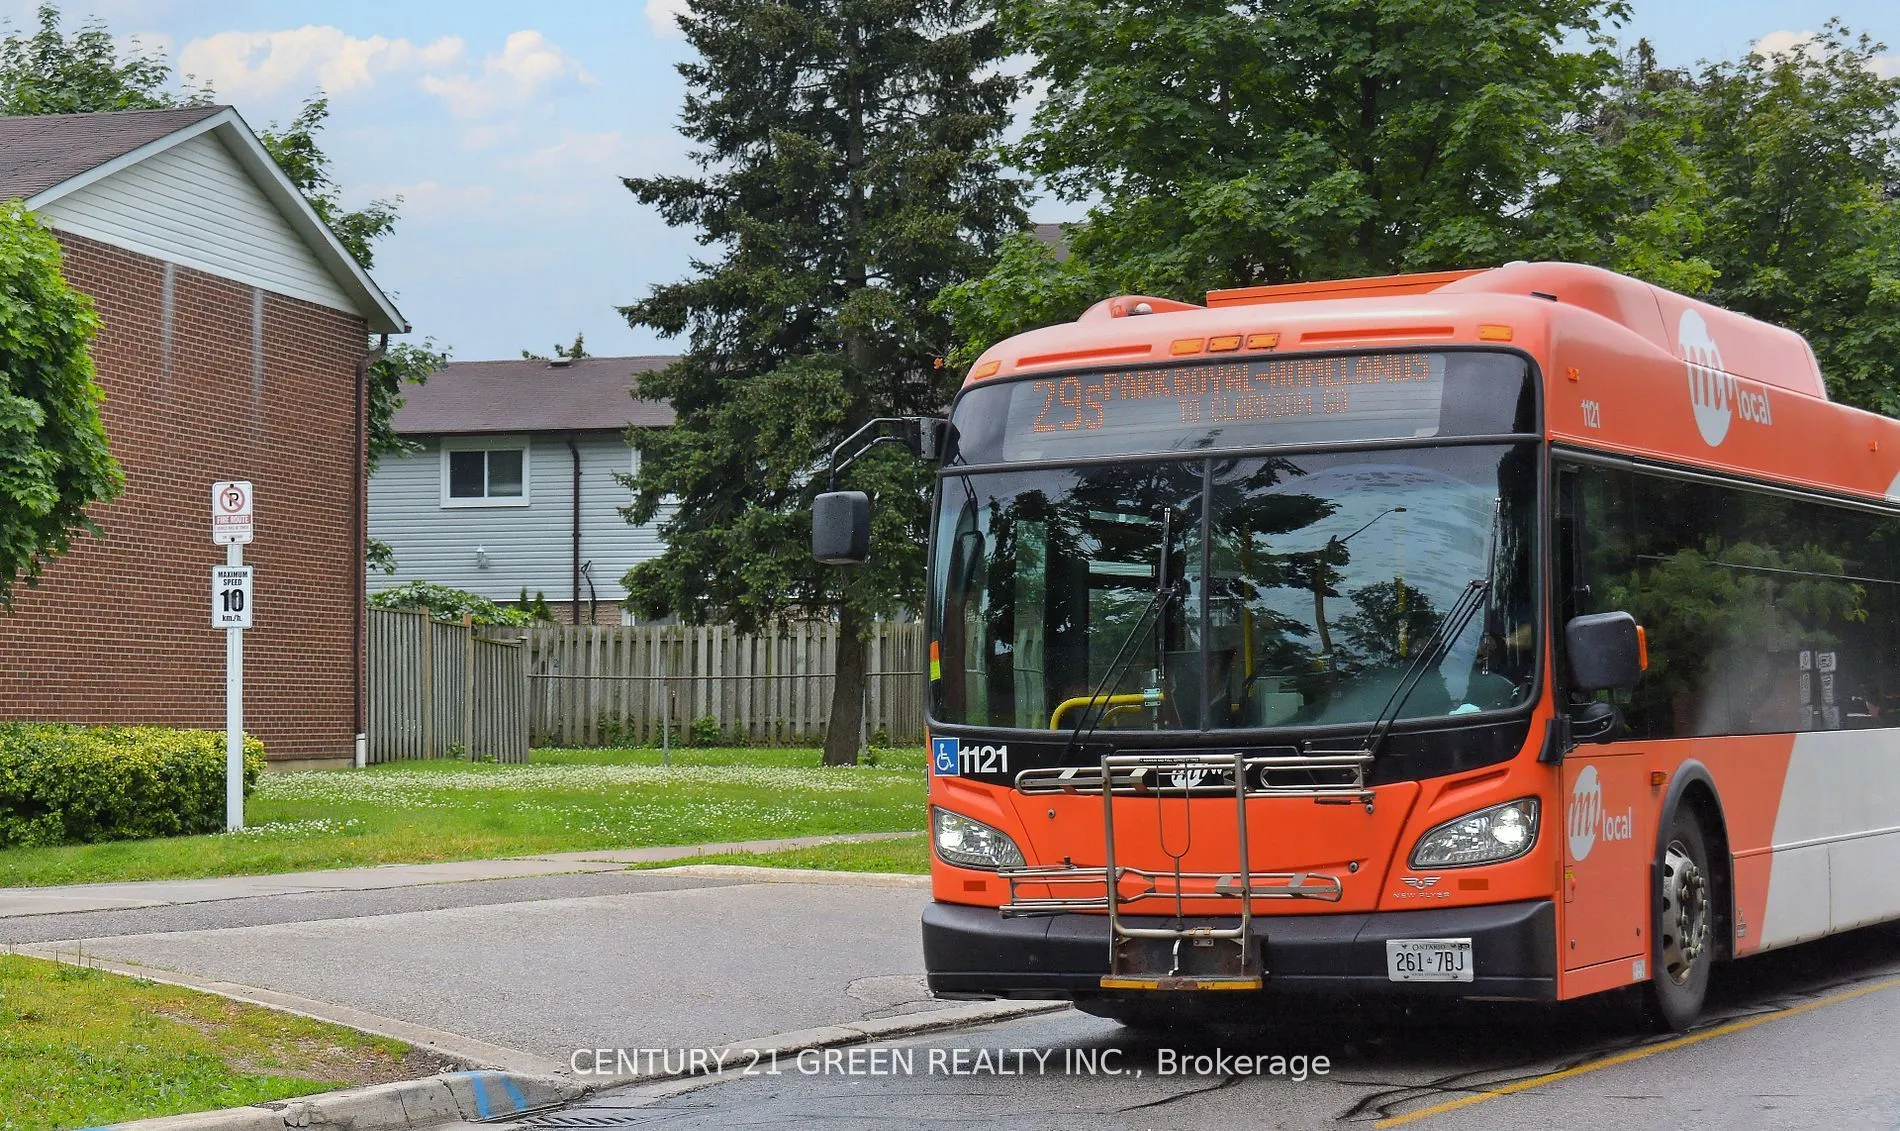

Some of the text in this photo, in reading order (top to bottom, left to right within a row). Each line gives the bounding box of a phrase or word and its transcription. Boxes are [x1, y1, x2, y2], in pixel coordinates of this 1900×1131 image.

[1178, 399, 1201, 424] TO
[1580, 399, 1601, 429] 1121
[1734, 380, 1773, 426] local
[216, 515, 249, 525] FIRE ROUTE
[220, 588, 244, 612] 10
[959, 745, 1008, 774] 1121
[1602, 806, 1632, 842] local
[1396, 951, 1463, 972] 261 7BJ
